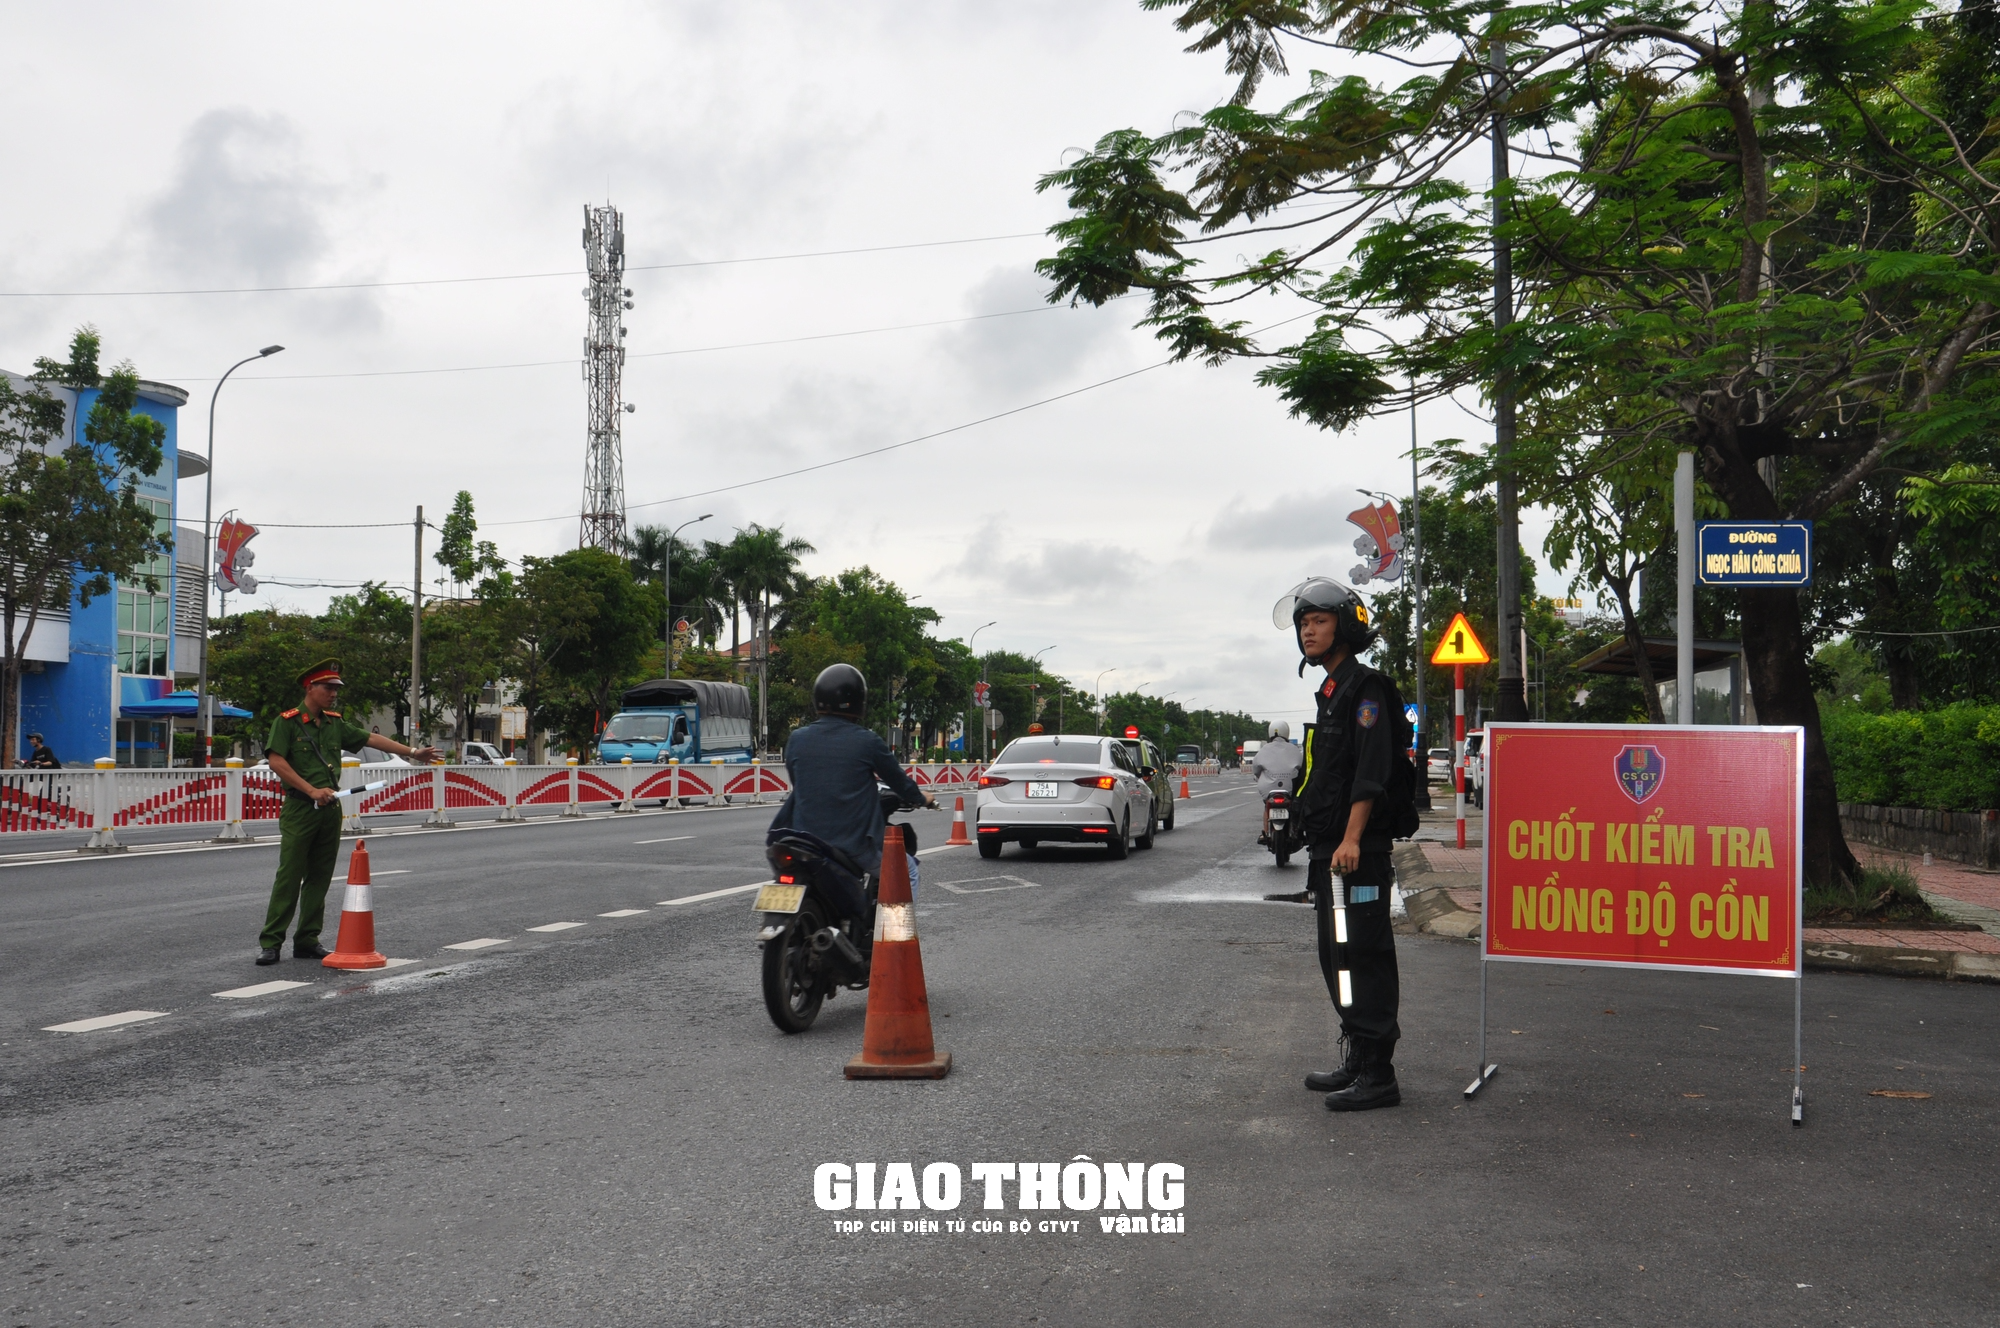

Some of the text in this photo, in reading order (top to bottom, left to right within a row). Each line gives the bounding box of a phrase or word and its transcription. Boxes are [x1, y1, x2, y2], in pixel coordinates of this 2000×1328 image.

[1729, 530, 1777, 543] ĐƯỜNG
[1706, 549, 1801, 578] NGỌC HÂN CÔNG CHÚA
[1622, 772, 1657, 781] CSGT
[1508, 807, 1774, 868] CHỐT KIỂM TRA
[1512, 872, 1769, 947] NỒNG ĐỘ CỒN
